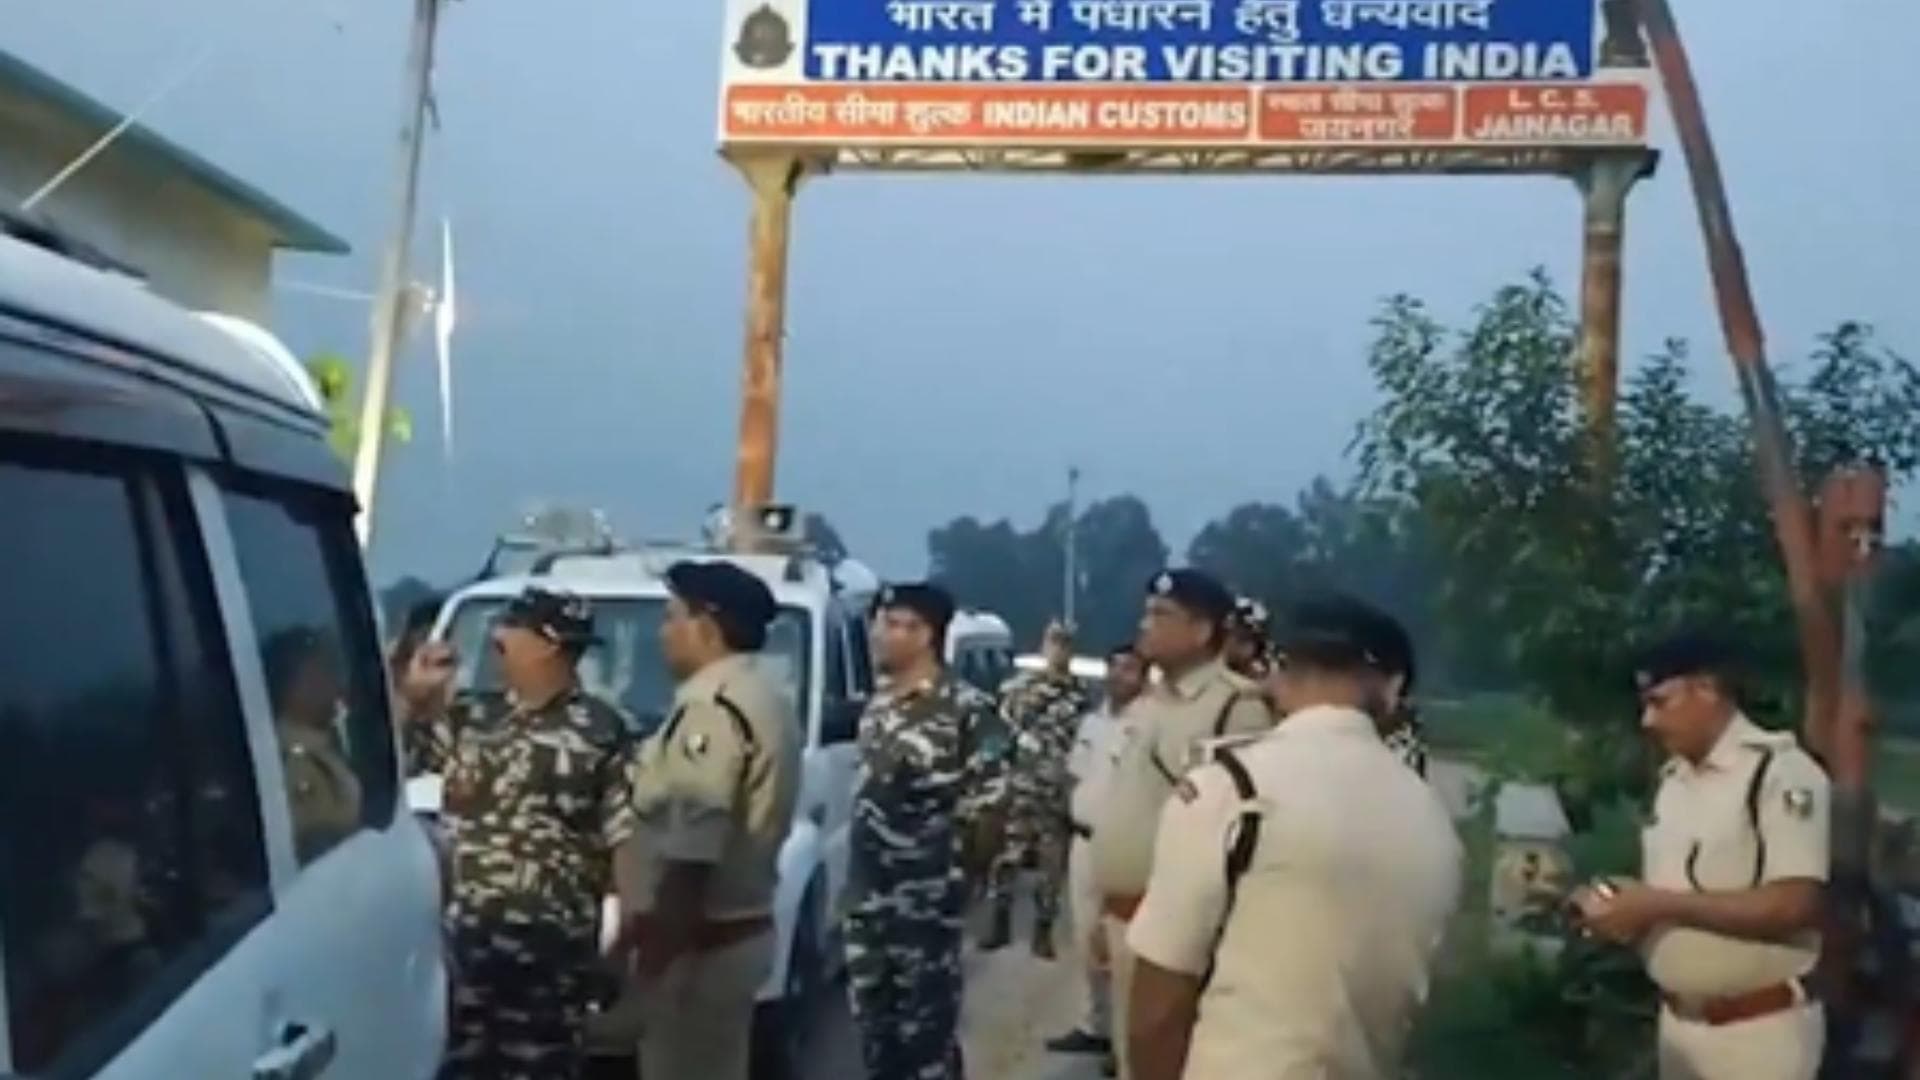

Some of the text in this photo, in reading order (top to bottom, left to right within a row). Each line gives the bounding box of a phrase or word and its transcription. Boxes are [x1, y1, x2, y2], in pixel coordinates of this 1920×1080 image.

[1069, 0, 1213, 31] पधारन
[1234, 0, 1299, 42] हतु
[813, 42, 1579, 80] THANKS FOR VISITING INDIA
[834, 89, 897, 126] सीमा
[982, 100, 1248, 129] INDIAN CUSTOMS
[1473, 111, 1635, 140] JAINAGAR
